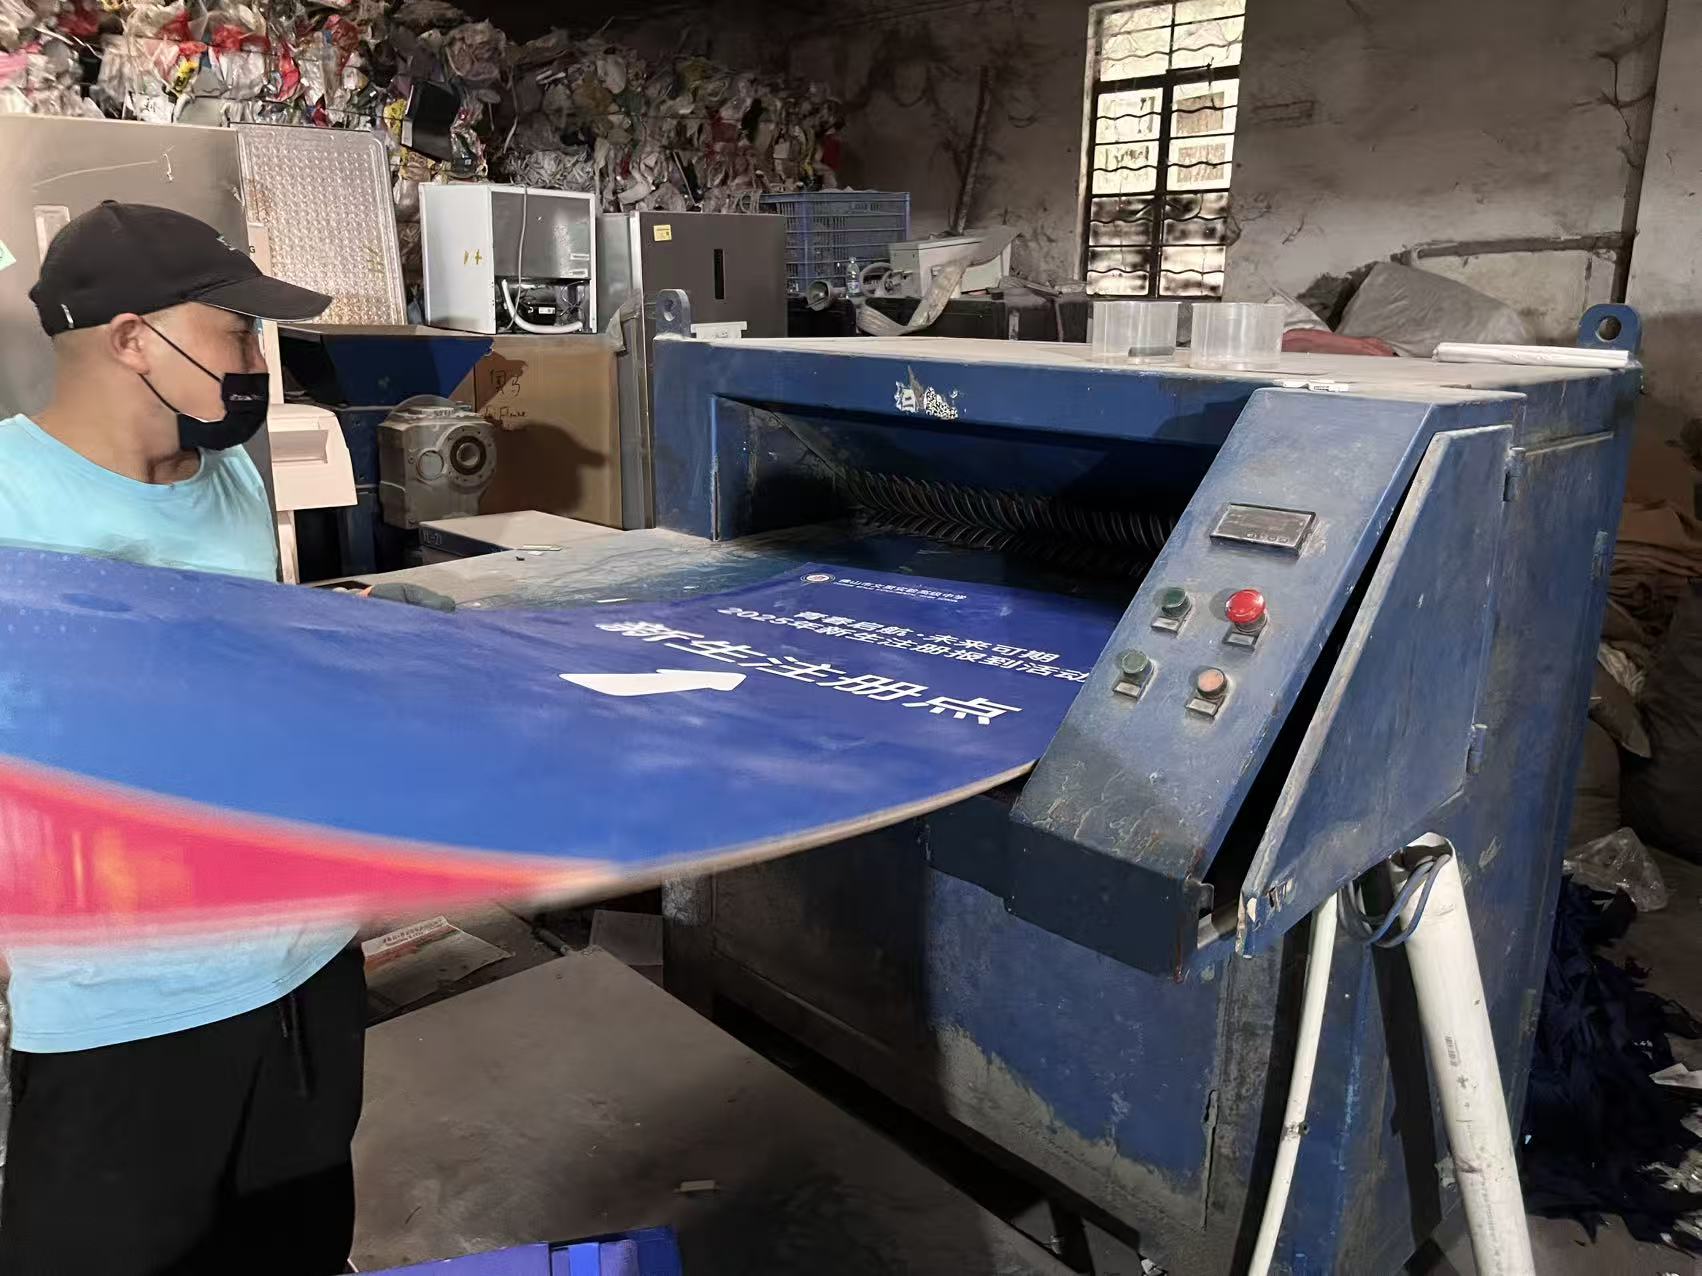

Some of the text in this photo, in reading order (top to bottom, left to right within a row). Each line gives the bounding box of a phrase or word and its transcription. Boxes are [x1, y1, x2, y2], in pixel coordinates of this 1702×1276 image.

[595, 621, 1022, 725] 新生注册点
[717, 607, 1091, 683] 2025年新生注册报到活动
[794, 611, 1060, 663] 青春启航·未来可期
